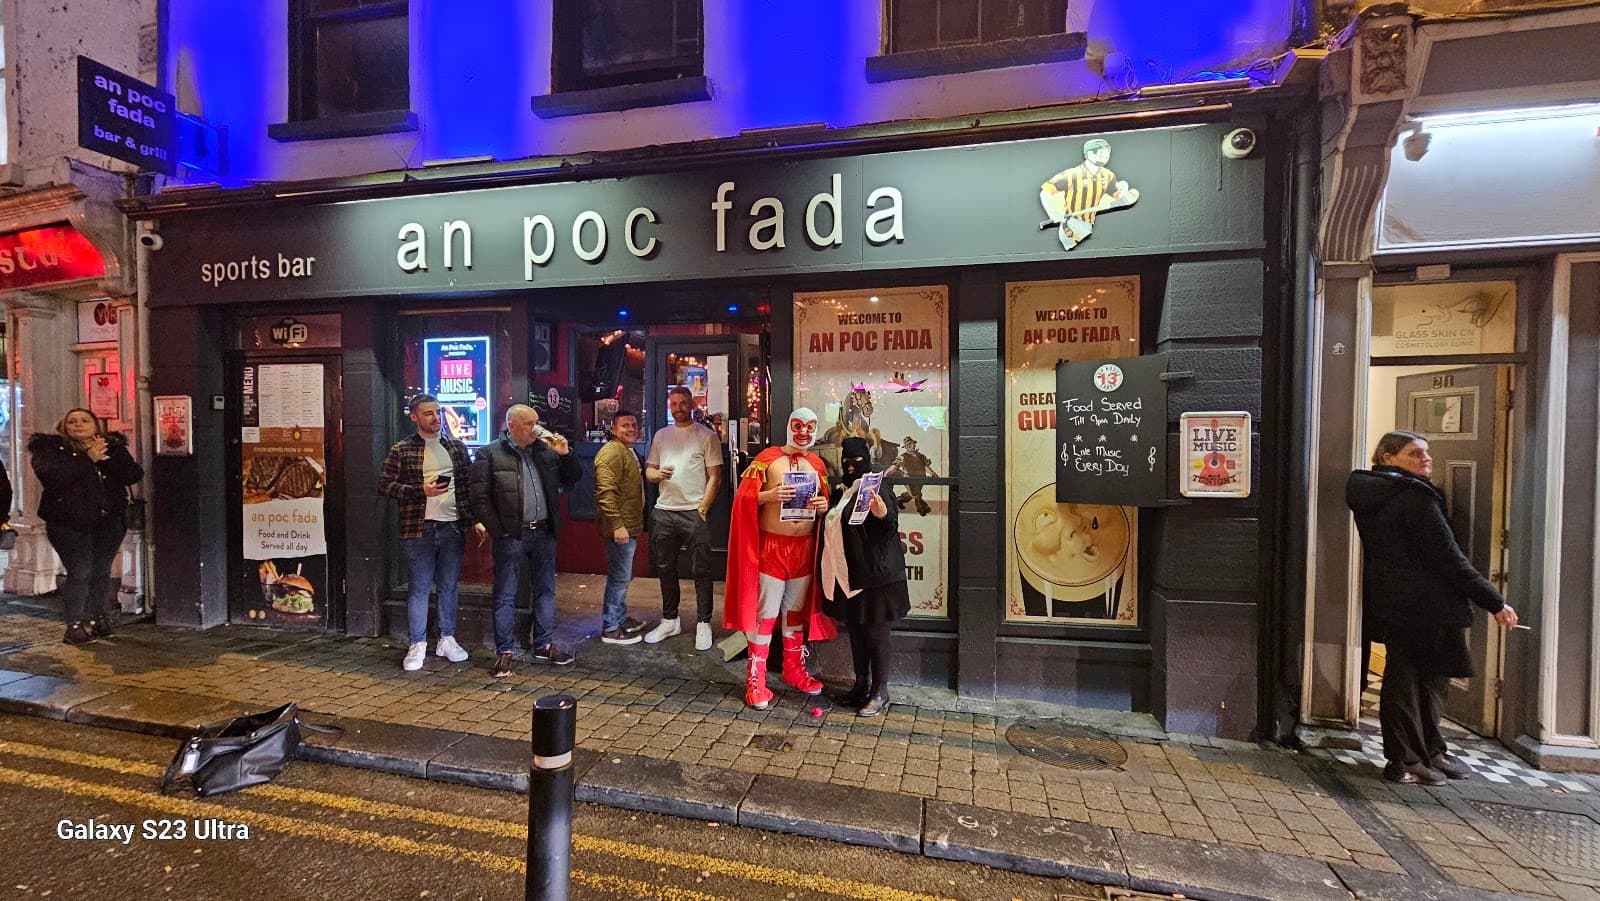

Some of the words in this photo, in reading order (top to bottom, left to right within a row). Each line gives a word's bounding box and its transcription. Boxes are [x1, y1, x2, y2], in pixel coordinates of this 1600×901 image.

[94, 75, 121, 95] an
[128, 89, 166, 113] poc
[108, 98, 155, 129] fada
[94, 124, 121, 143] bar
[125, 136, 137, 150] &
[140, 144, 167, 161] grill
[396, 218, 473, 272] an
[523, 206, 657, 281] poc
[711, 173, 905, 252] fada
[201, 255, 271, 286] sports
[277, 253, 316, 279] bar
[838, 313, 887, 326] WELCOME
[889, 312, 902, 324] TO
[1036, 308, 1091, 322] WELCOME
[1093, 307, 1108, 320] TO
[809, 332, 834, 353] AN
[840, 330, 878, 352] POC
[884, 328, 933, 351] FADA
[1023, 328, 1044, 345] AN
[1047, 327, 1078, 344] POC
[1082, 326, 1121, 343] FADA
[1395, 330, 1429, 339] GLASS
[1431, 329, 1457, 338] SKIN
[444, 362, 470, 376] LIVE
[243, 367, 254, 394] MENU
[440, 378, 473, 394] MUSIC
[1097, 372, 1118, 385] 13
[1062, 398, 1093, 412] Food
[1193, 429, 1237, 442] LIVE
[1193, 442, 1237, 452] MUSIC
[1105, 458, 1130, 476] Day
[251, 513, 265, 522] an
[268, 513, 289, 528] poc
[292, 508, 317, 523] fada
[258, 529, 275, 538] Food
[276, 530, 289, 539] and
[291, 530, 311, 539] Drink
[261, 541, 285, 550] Served
[286, 542, 294, 551] all
[296, 542, 308, 553] day
